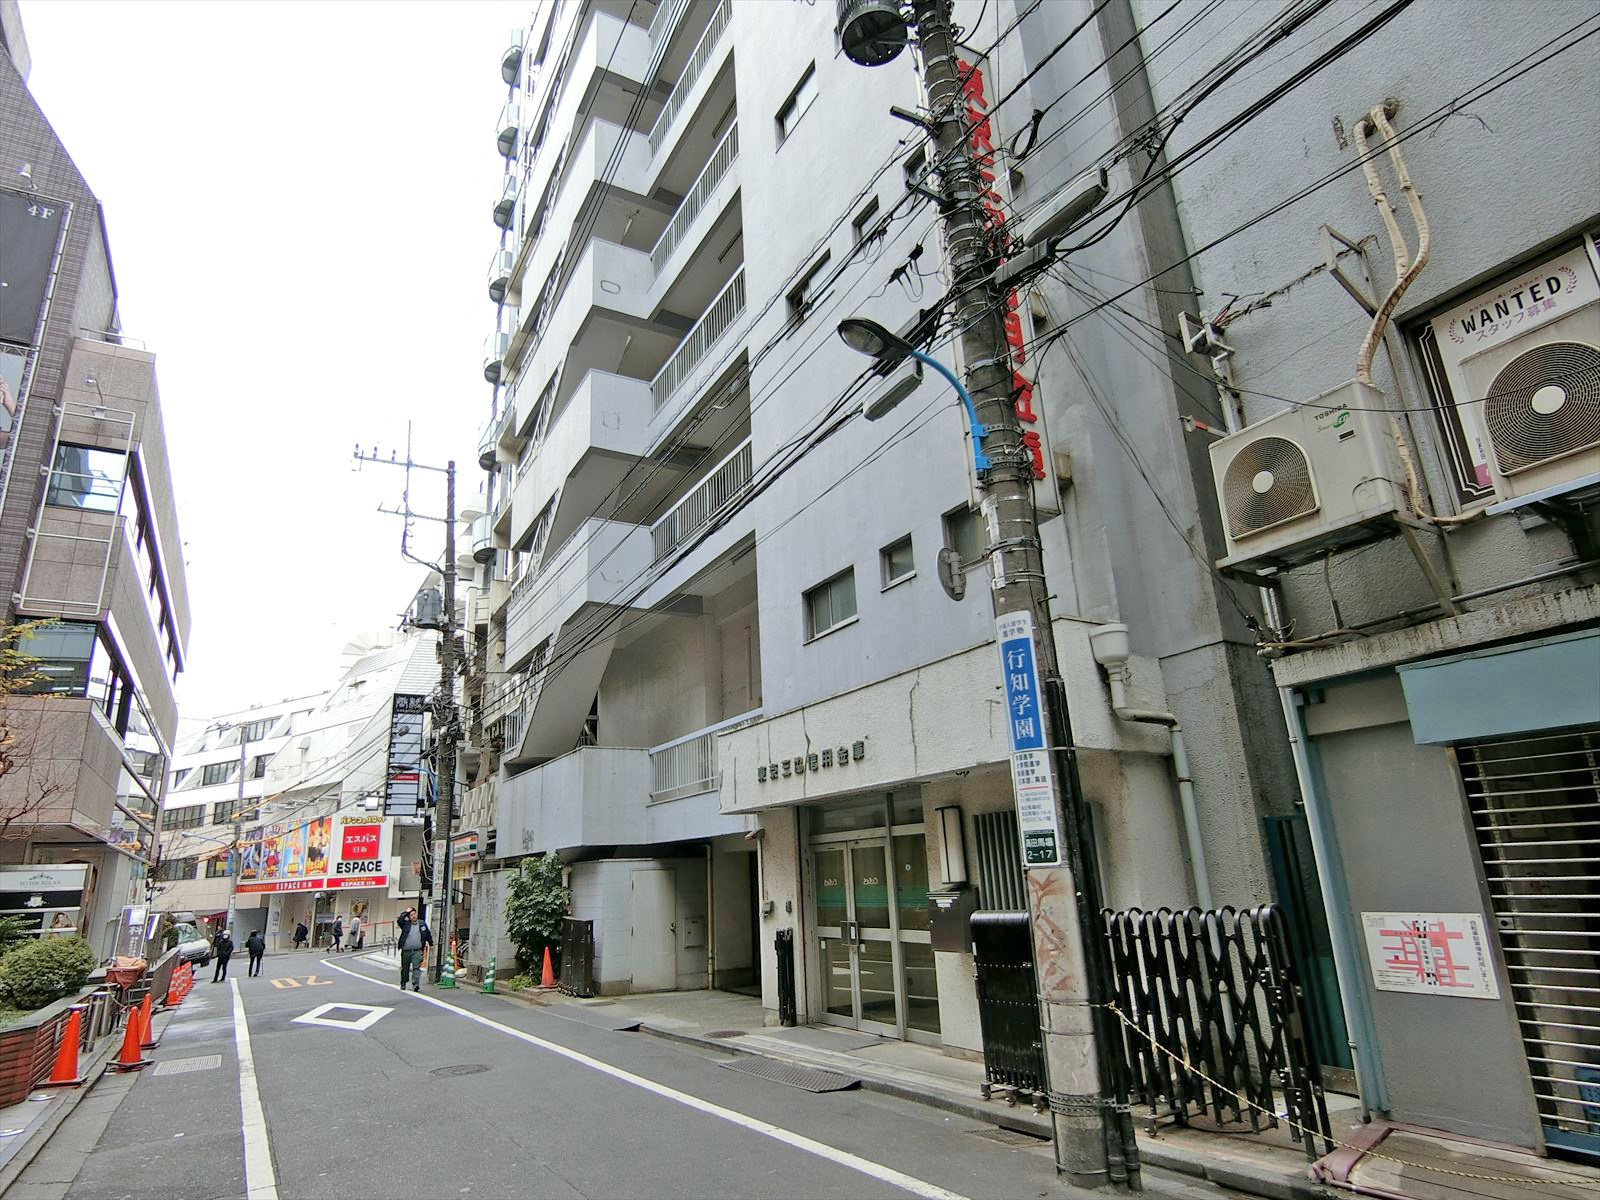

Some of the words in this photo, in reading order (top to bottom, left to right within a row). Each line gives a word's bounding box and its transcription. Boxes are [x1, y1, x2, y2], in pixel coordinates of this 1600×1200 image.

[1460, 276, 1562, 335] WANTED
[1475, 297, 1558, 343] スタッフ募集
[1313, 403, 1348, 421] TOSHIBA
[1006, 648, 1036, 740] 行知学園
[757, 740, 865, 783] 東京三協信用金庫
[345, 832, 377, 844] エスパス
[1027, 850, 1053, 860] 2-17
[336, 861, 383, 874] ESPACE
[275, 882, 301, 891] ESPACE
